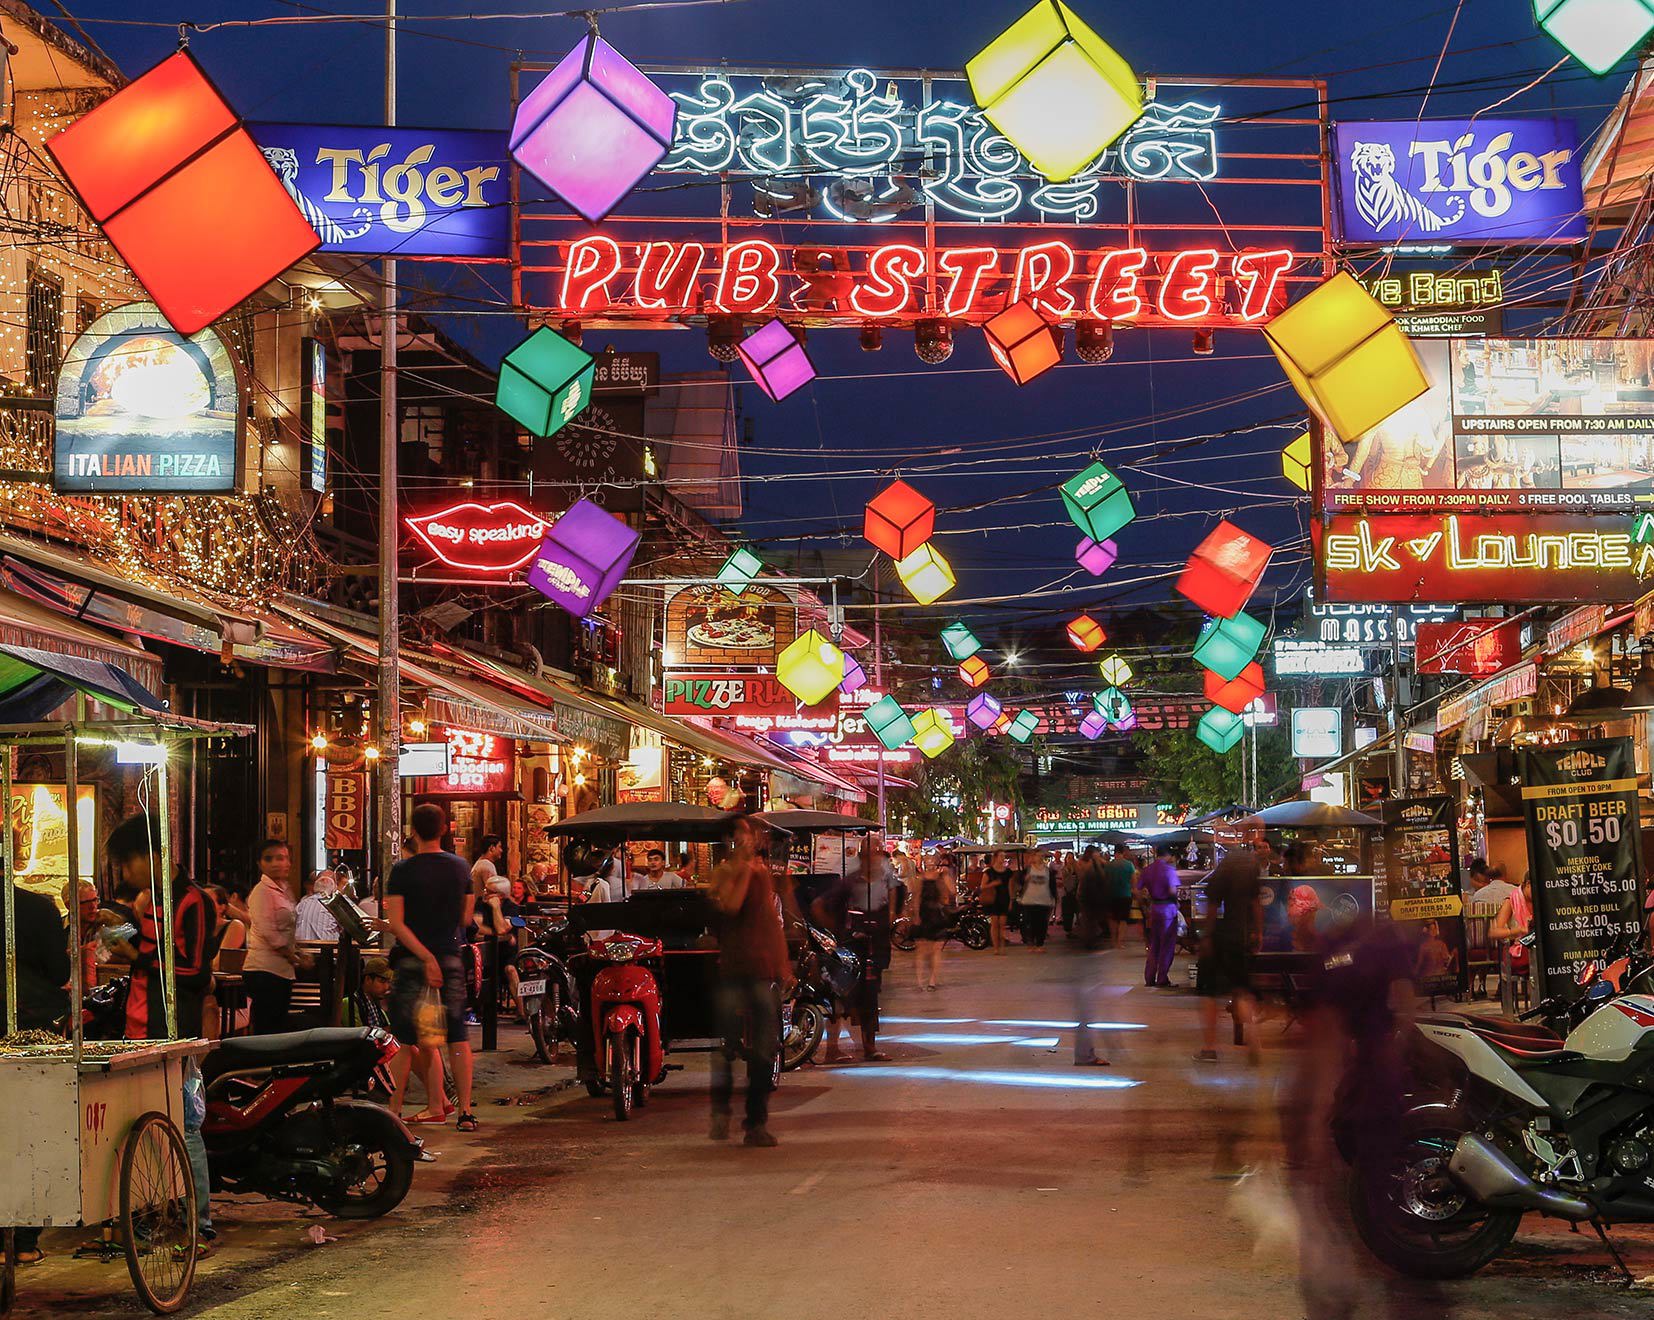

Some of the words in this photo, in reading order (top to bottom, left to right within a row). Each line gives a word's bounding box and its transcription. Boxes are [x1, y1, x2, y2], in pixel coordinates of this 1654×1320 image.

[1409, 132, 1572, 217] Tiger
[316, 142, 500, 233] Tiger
[559, 236, 779, 316] PUB
[850, 240, 1294, 322] STREET
[1410, 269, 1503, 305] Band
[1462, 419, 1515, 430] UPSTAIRS
[1517, 419, 1548, 430] OPEN
[1550, 419, 1582, 430] FROM
[1584, 419, 1606, 430] 7:30
[1607, 419, 1625, 429] AM
[68, 453, 152, 477] ITALIAN
[159, 453, 221, 477] PIZZA
[1334, 495, 1364, 506] FREE
[1366, 494, 1400, 506] SHOW
[1403, 494, 1436, 506] FROM
[1438, 494, 1476, 505] 7:30PM
[1479, 494, 1512, 505] DAILY.
[1518, 494, 1526, 505] 3
[1528, 494, 1556, 505] FREE
[1558, 494, 1589, 505] POOL
[1590, 493, 1634, 505] TABLES.
[427, 522, 465, 544] easy
[469, 521, 543, 545] speaking
[537, 558, 590, 599] TEMPLE
[1320, 617, 1444, 641] MASSA
[666, 680, 793, 709] PIZZERIA
[1556, 751, 1606, 771] TEMPLE
[1571, 768, 1592, 777] CLUB
[1547, 788, 1567, 796] FROM
[1568, 786, 1586, 794] OPEN
[1597, 783, 1612, 791] 9PM
[331, 777, 357, 833] BBQ
[1400, 804, 1433, 818] TEMPLE
[1536, 803, 1585, 822] DRAFT
[1588, 800, 1627, 817] BEER
[1036, 822, 1055, 830] HUY
[1110, 821, 1138, 829] MART
[1546, 817, 1621, 851] $0.50
[1556, 864, 1591, 875] WHISKEY
[1592, 863, 1612, 872] COKE
[1567, 855, 1600, 866] MEKONG
[1545, 879, 1570, 889] GLASS
[1570, 872, 1604, 887] $1.75
[1571, 886, 1600, 896] BUCKET
[1602, 879, 1637, 894] $5.00
[1556, 906, 1582, 916] VODKA
[1583, 904, 1599, 913] RED
[1600, 903, 1621, 912] BULL
[1549, 921, 1573, 931] GLASS
[1574, 914, 1608, 930] $2.00
[1575, 928, 1603, 938] BUCKET
[1606, 921, 1640, 937] $5.50
[1563, 951, 1582, 960] RUM
[1583, 949, 1599, 958] AND
[1547, 965, 1572, 975] GLASS
